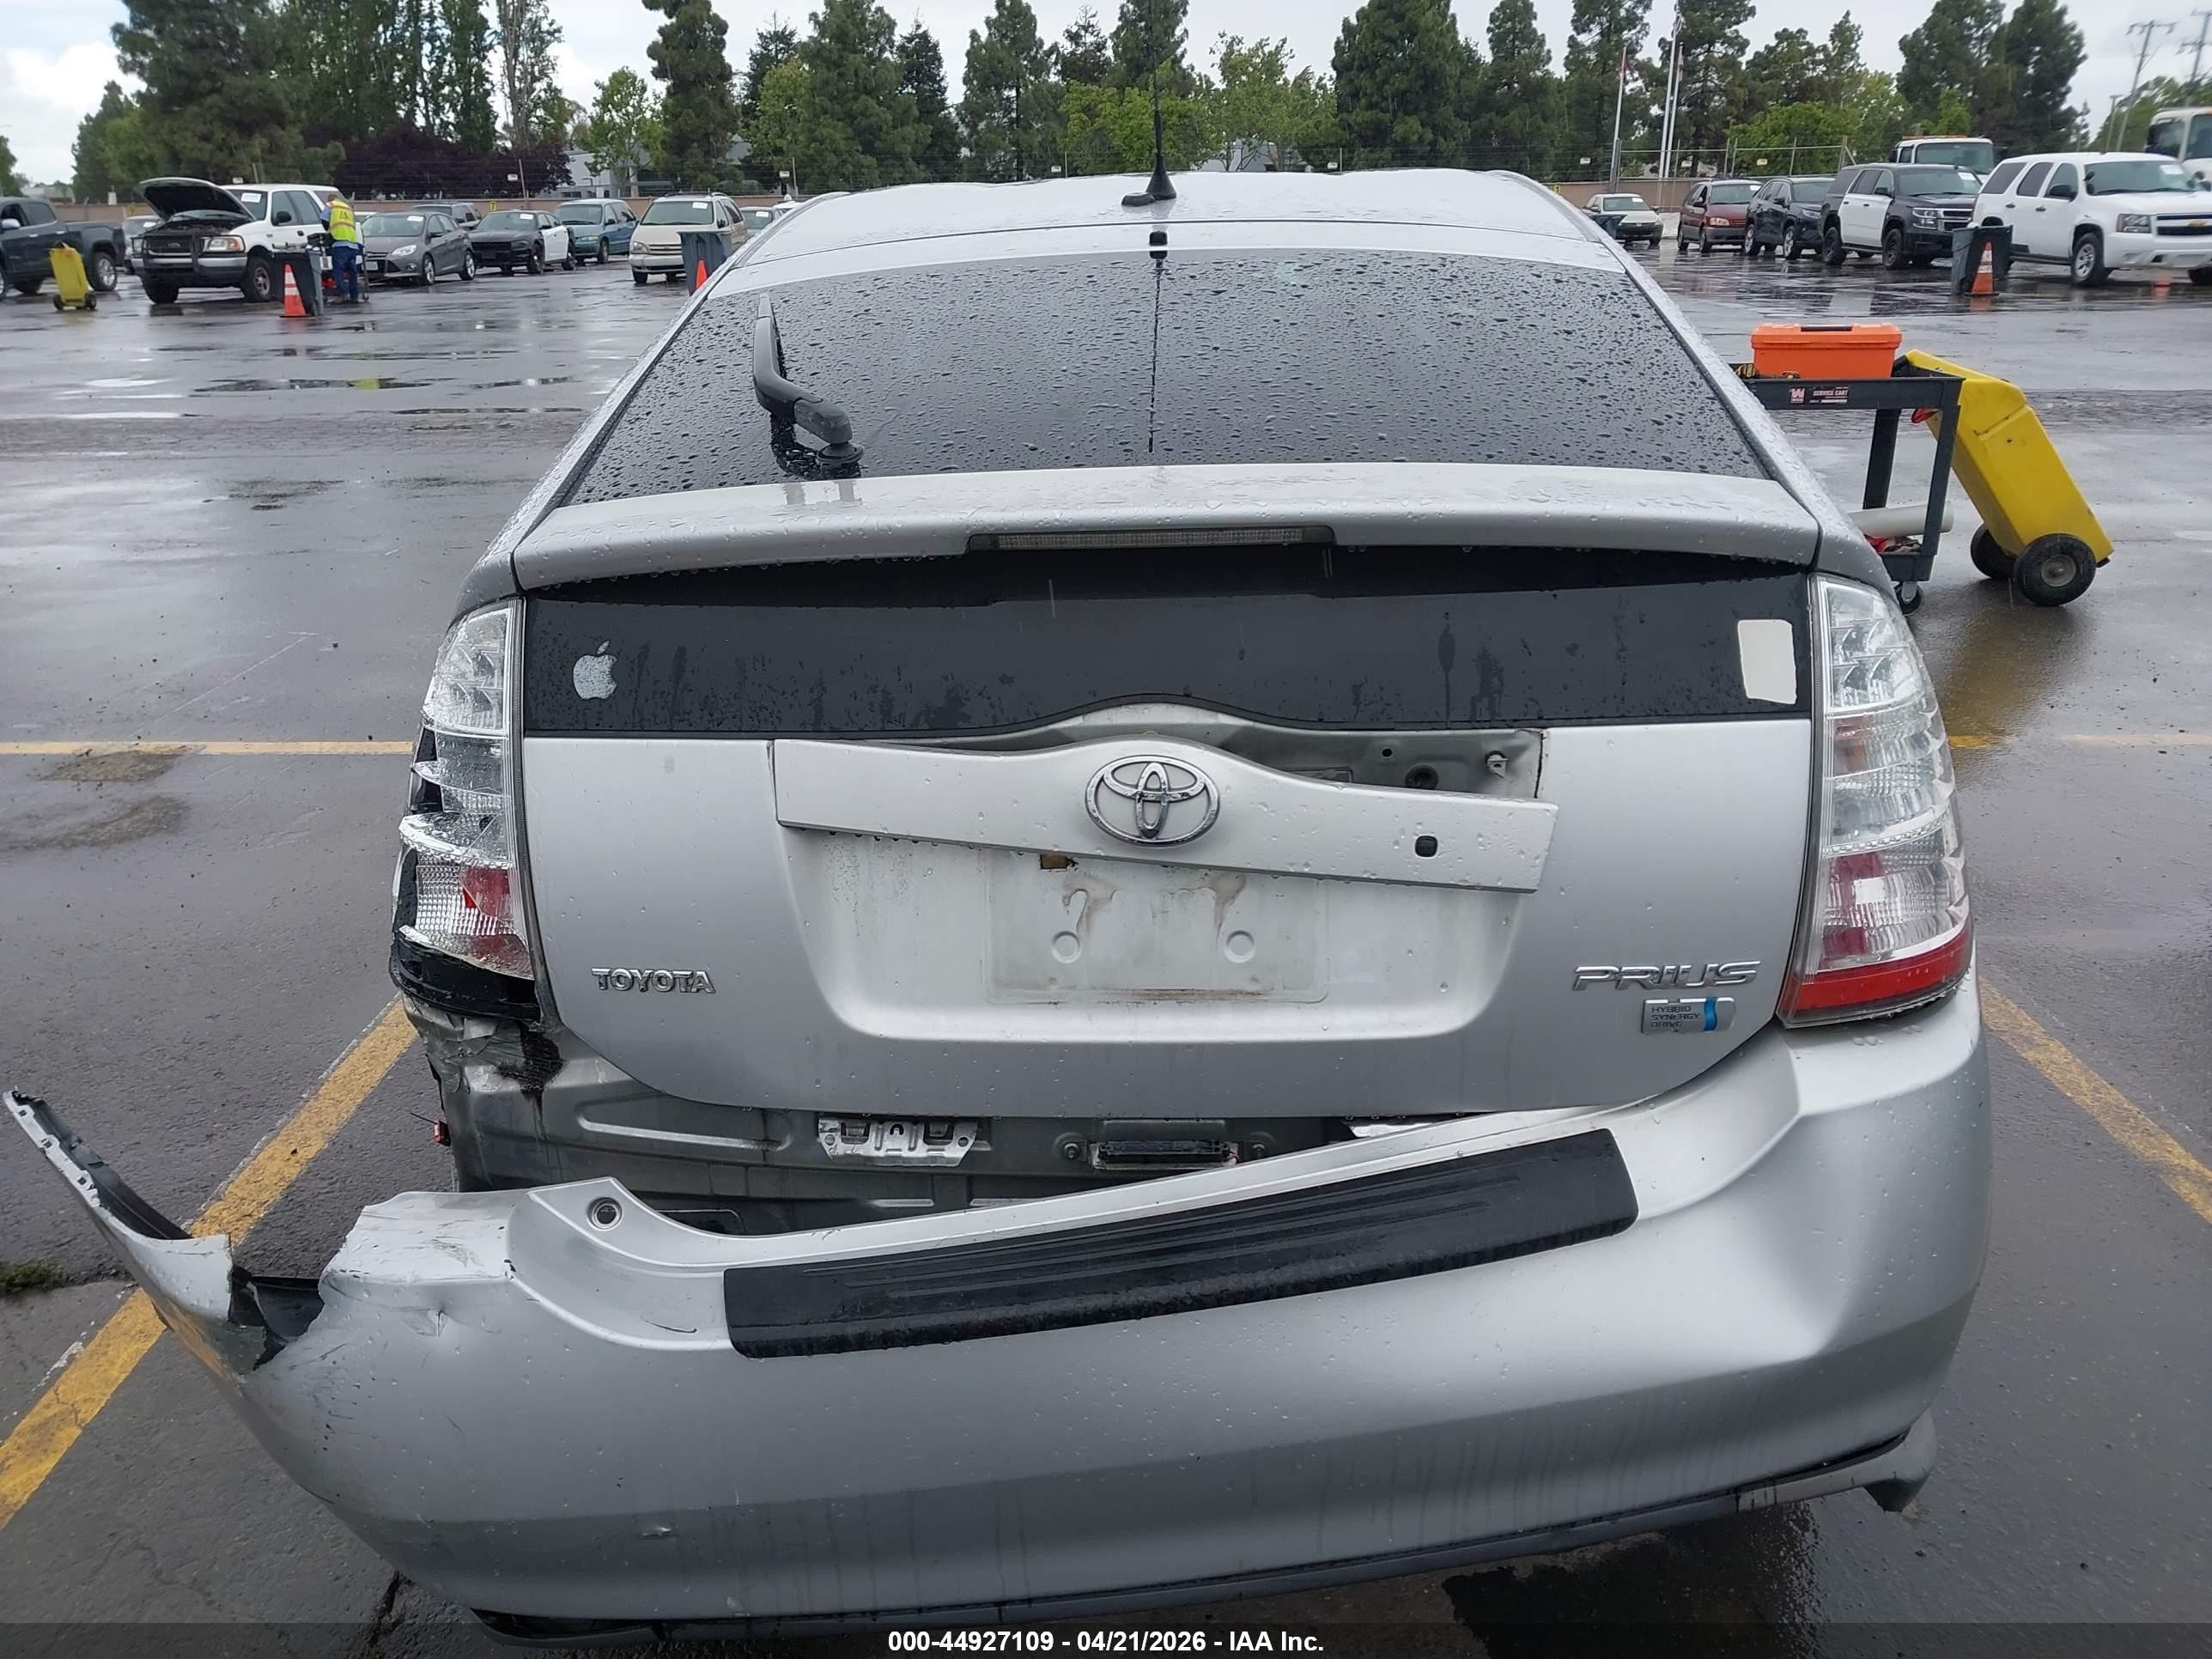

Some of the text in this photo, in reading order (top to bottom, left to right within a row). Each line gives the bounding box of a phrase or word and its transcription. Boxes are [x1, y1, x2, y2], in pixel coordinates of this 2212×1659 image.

[1572, 960, 1761, 990] PRIUS
[591, 968, 715, 994] TOYOTA
[1650, 1005, 1692, 1013] HYBRID
[1650, 1012, 1700, 1021] SYNERGY
[1650, 1020, 1683, 1029] DRIVE
